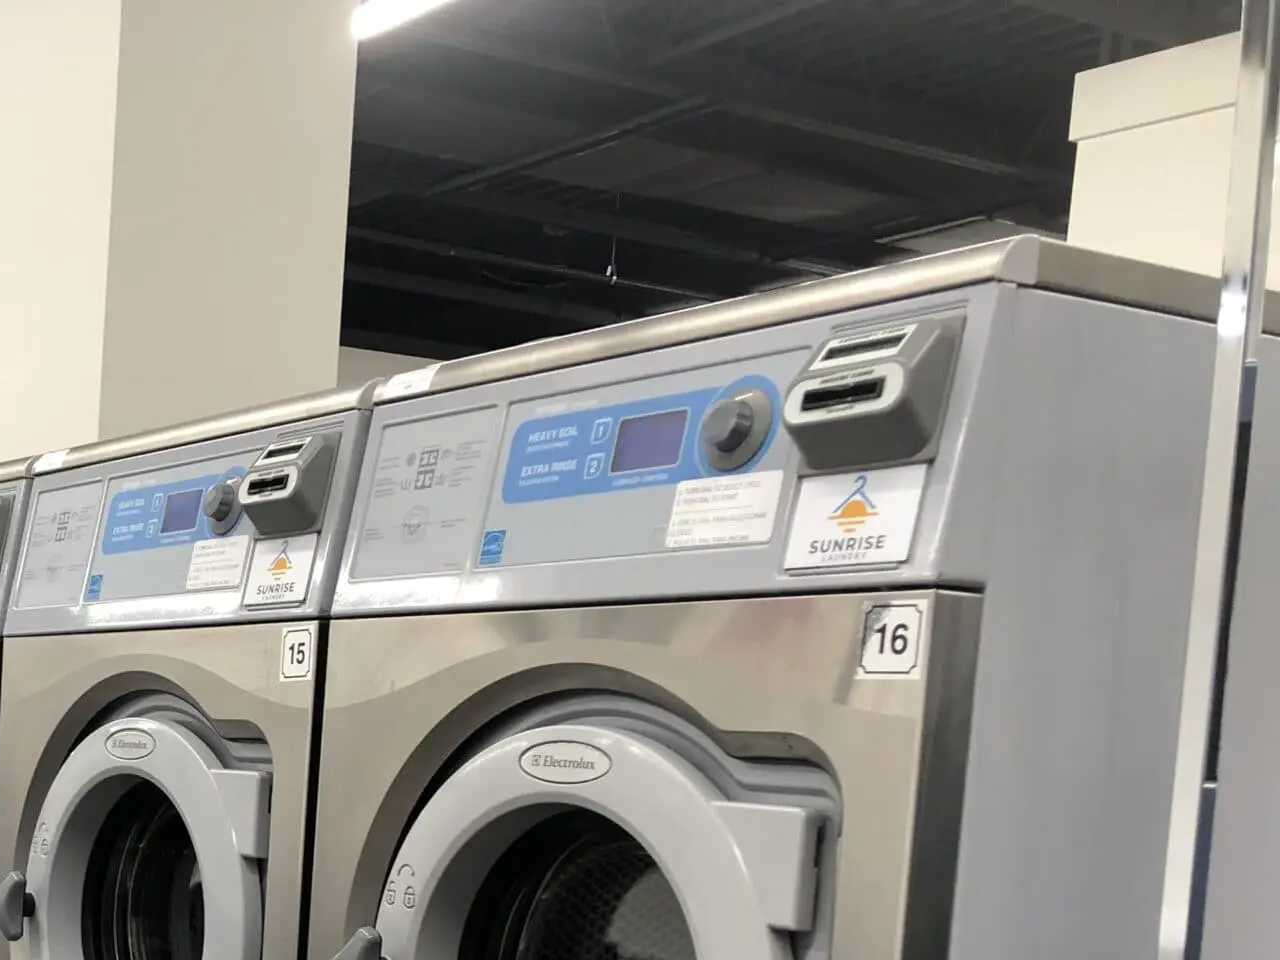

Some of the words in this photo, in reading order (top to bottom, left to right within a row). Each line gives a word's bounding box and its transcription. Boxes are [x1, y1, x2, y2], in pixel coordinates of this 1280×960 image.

[528, 430, 557, 443] HEAVY
[521, 463, 550, 477] EXTRA
[551, 459, 578, 473] RINSE
[809, 534, 887, 554] SUNRISE
[821, 552, 868, 562] LAUNDRY
[256, 582, 296, 596] SUNRISE
[875, 623, 909, 655] 16
[288, 642, 306, 665] 15
[543, 755, 596, 770] Electrolux
